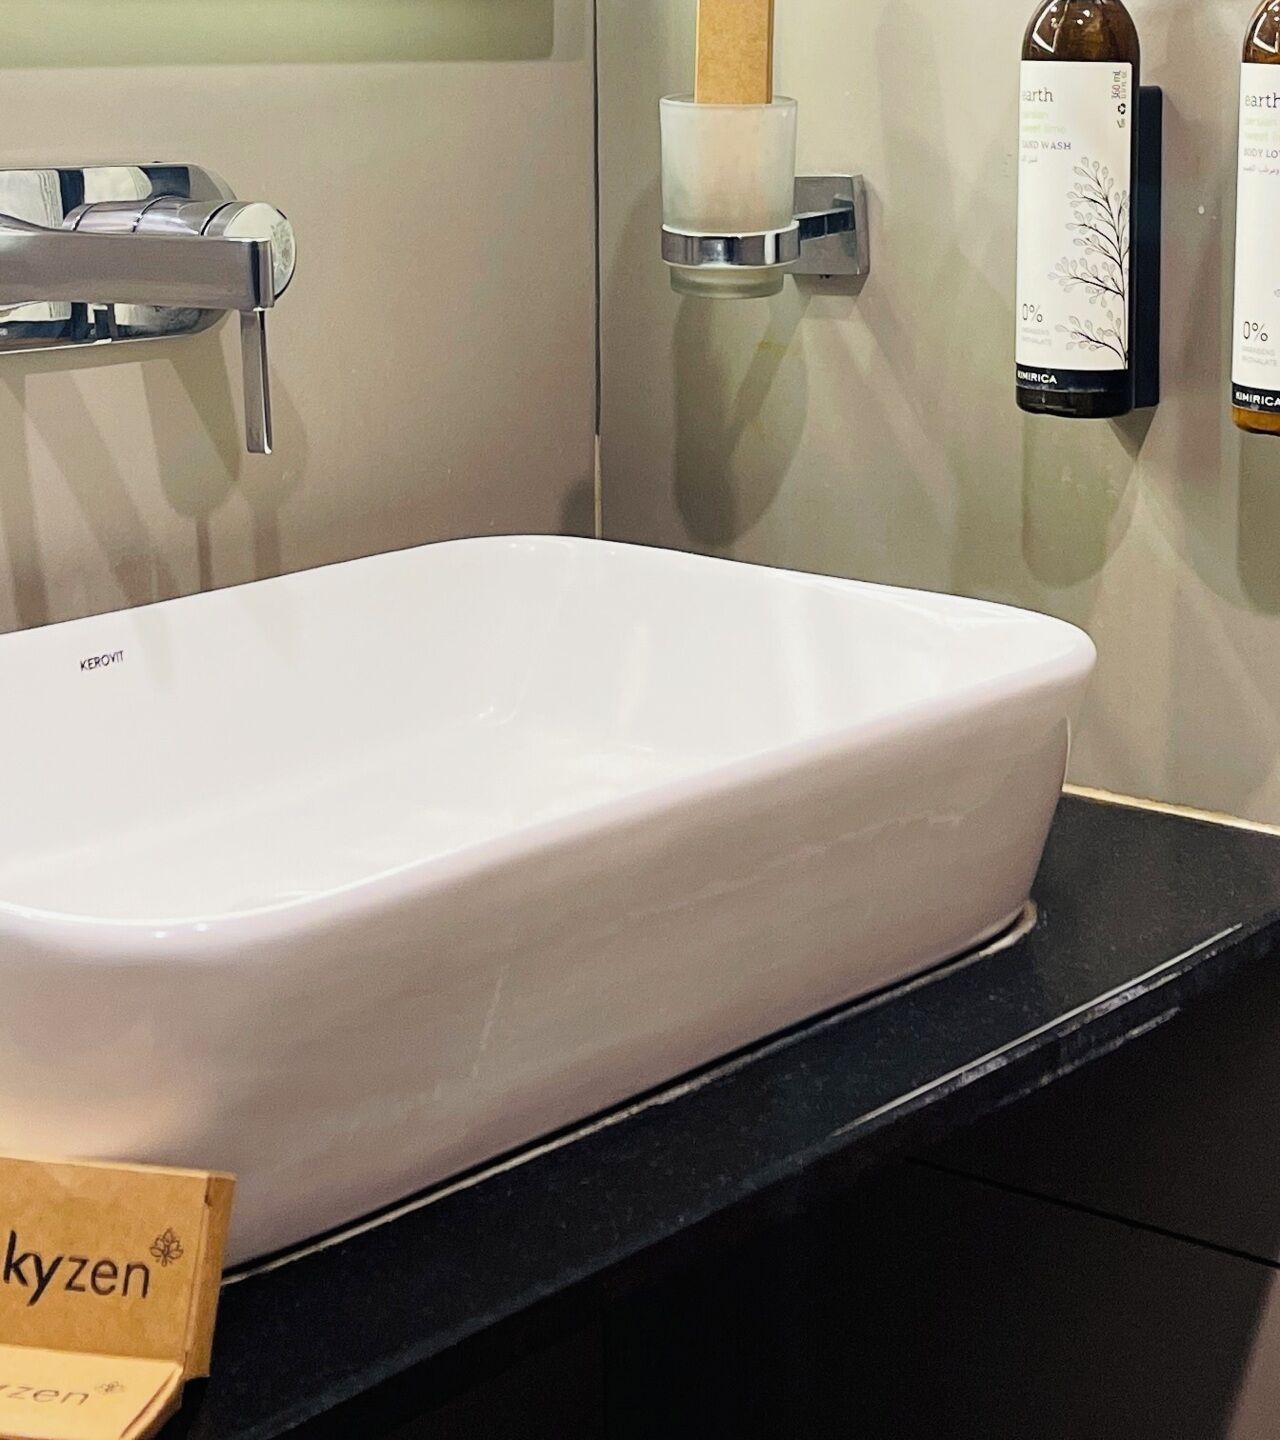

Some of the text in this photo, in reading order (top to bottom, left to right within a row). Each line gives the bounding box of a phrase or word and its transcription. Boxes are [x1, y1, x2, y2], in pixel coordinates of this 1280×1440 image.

[1041, 141, 1072, 150] WASH
[1022, 303, 1044, 323] 0%
[1243, 321, 1269, 342] 0%
[80, 650, 124, 672] KEROVIT
[3, 1229, 150, 1307] kyzen
